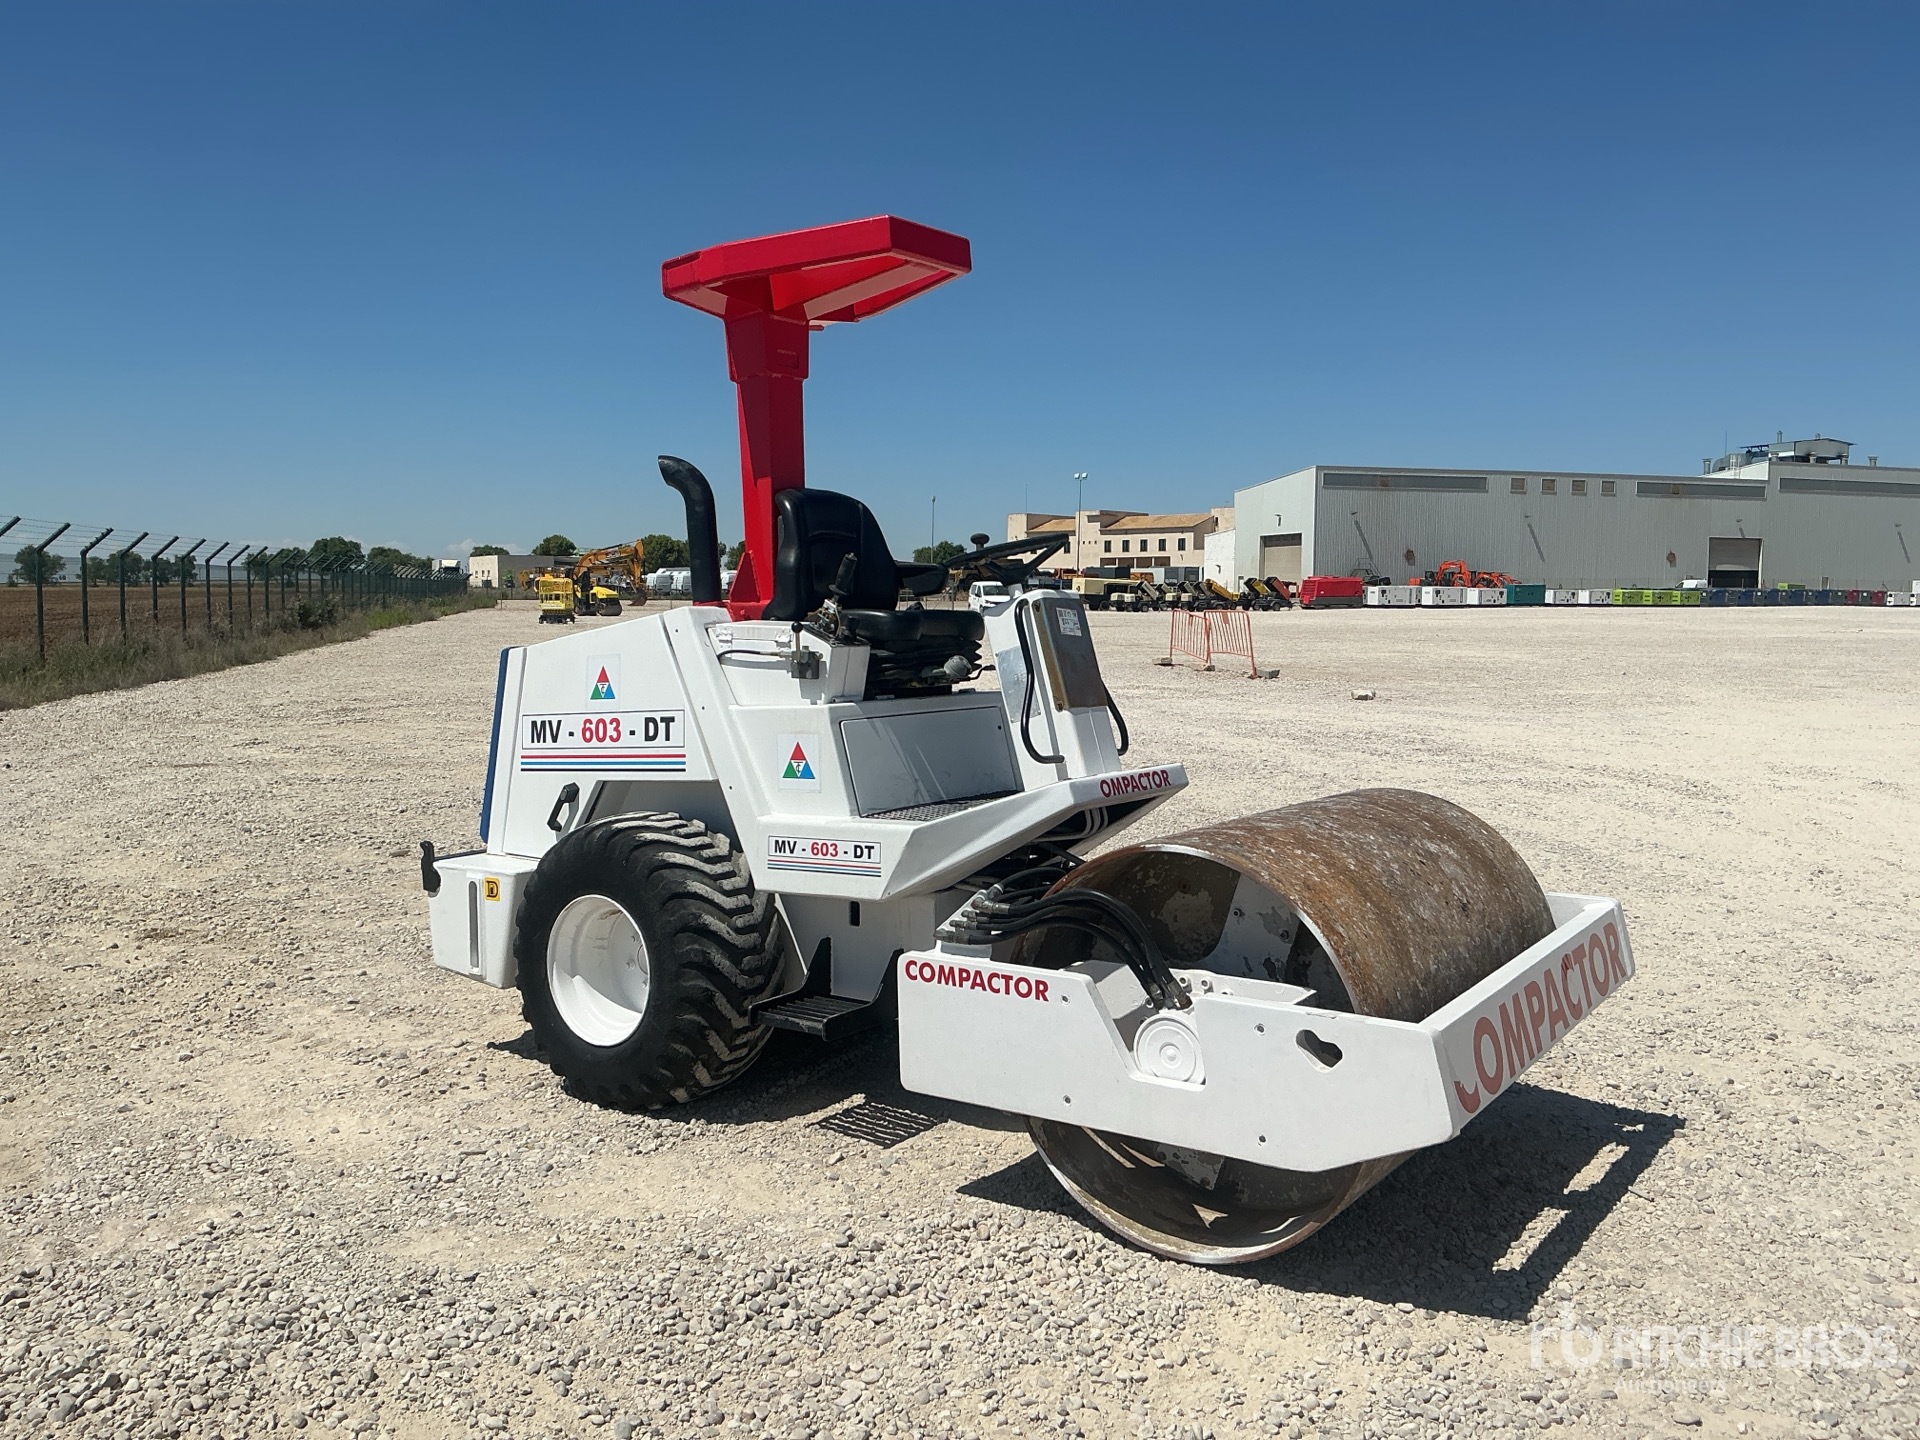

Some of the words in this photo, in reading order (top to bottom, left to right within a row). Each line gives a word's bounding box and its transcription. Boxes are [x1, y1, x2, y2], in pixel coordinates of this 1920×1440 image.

[530, 719, 562, 743] MV
[581, 717, 622, 743] 603
[644, 716, 676, 742] DT
[1100, 769, 1172, 798] OMPACTOR
[774, 839, 797, 854] MV
[810, 841, 839, 857] 603
[853, 844, 875, 859] DT
[904, 959, 1050, 1002] COMPACTOR
